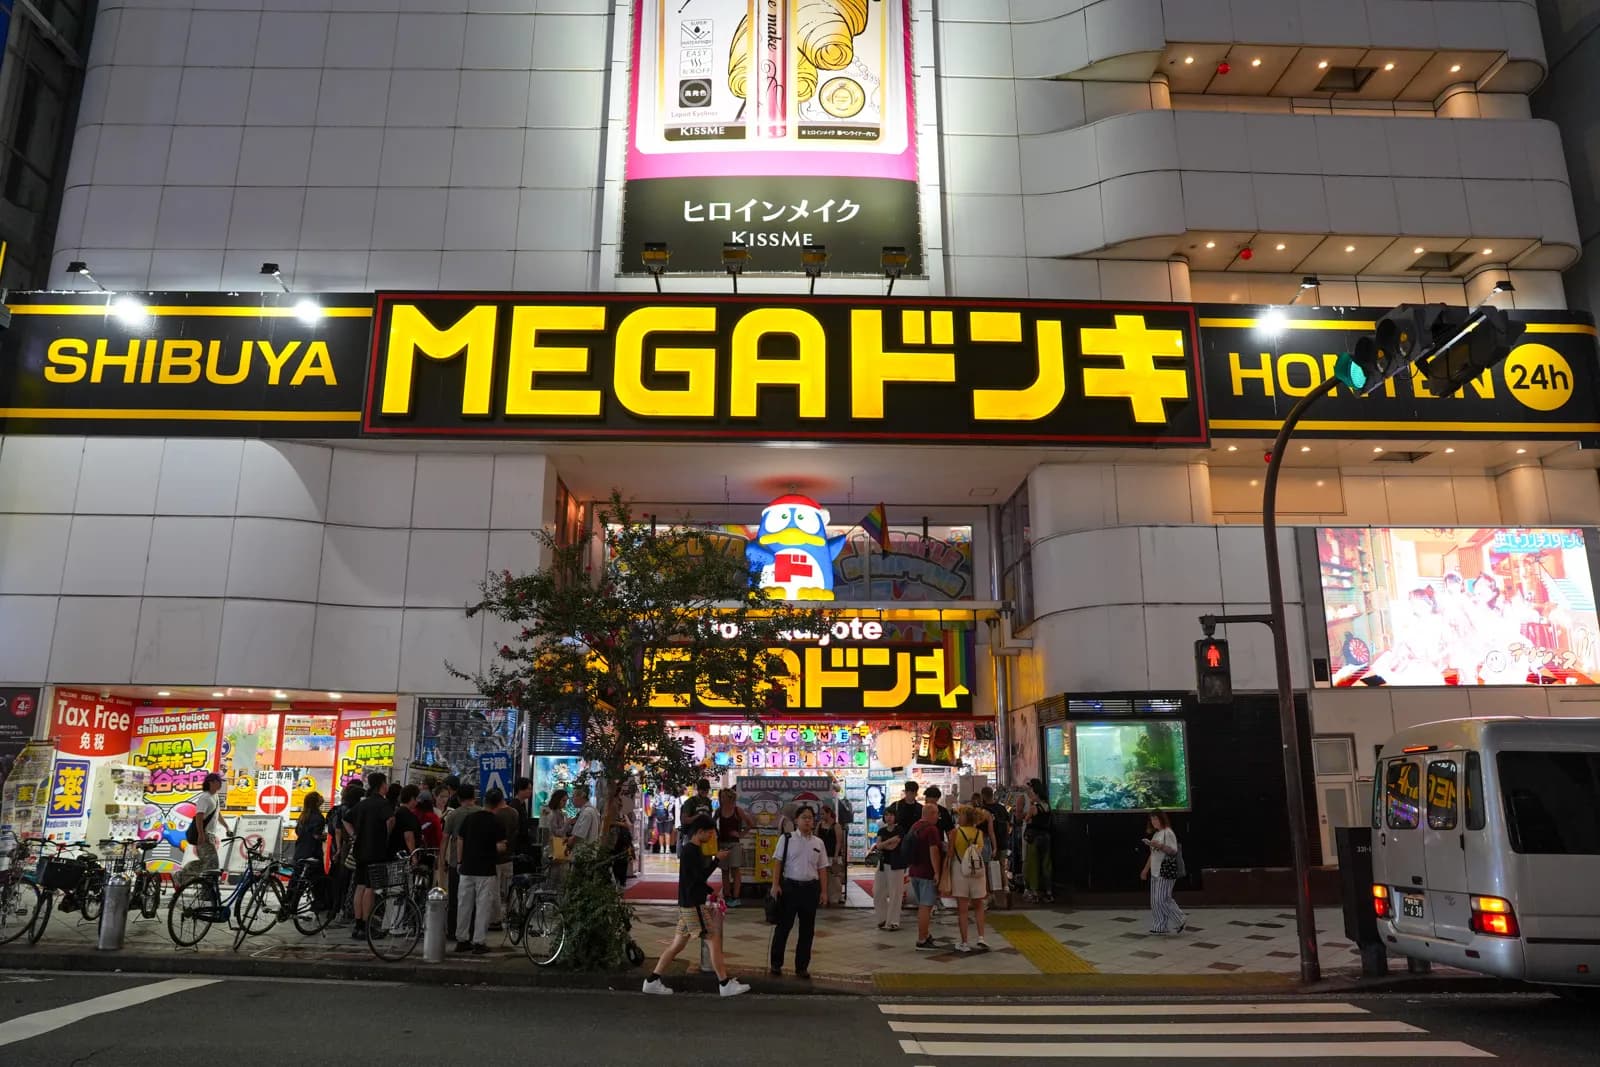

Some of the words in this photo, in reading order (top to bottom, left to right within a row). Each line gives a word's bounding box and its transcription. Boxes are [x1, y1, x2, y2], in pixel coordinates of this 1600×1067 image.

[768, 14, 782, 51] make
[683, 199, 860, 223] ヒロインメイク
[44, 338, 338, 386] SHIBUYA
[381, 304, 1190, 424] MEGAドンキ
[1512, 364, 1570, 391] 24h
[595, 647, 970, 709] EGAドンキ
[58, 700, 91, 728] Tax
[94, 705, 131, 732] Free
[137, 724, 177, 735] Shibuya
[178, 721, 215, 732] Honten
[144, 717, 164, 725] MEGA
[181, 713, 210, 723] Quijote
[350, 719, 371, 728] MEGA
[371, 718, 387, 727] Don
[79, 732, 105, 750] 免税
[344, 728, 384, 738] Shibuya
[149, 740, 193, 756] MEGA
[53, 766, 87, 811] 薬
[742, 779, 788, 789] SHIBUYA
